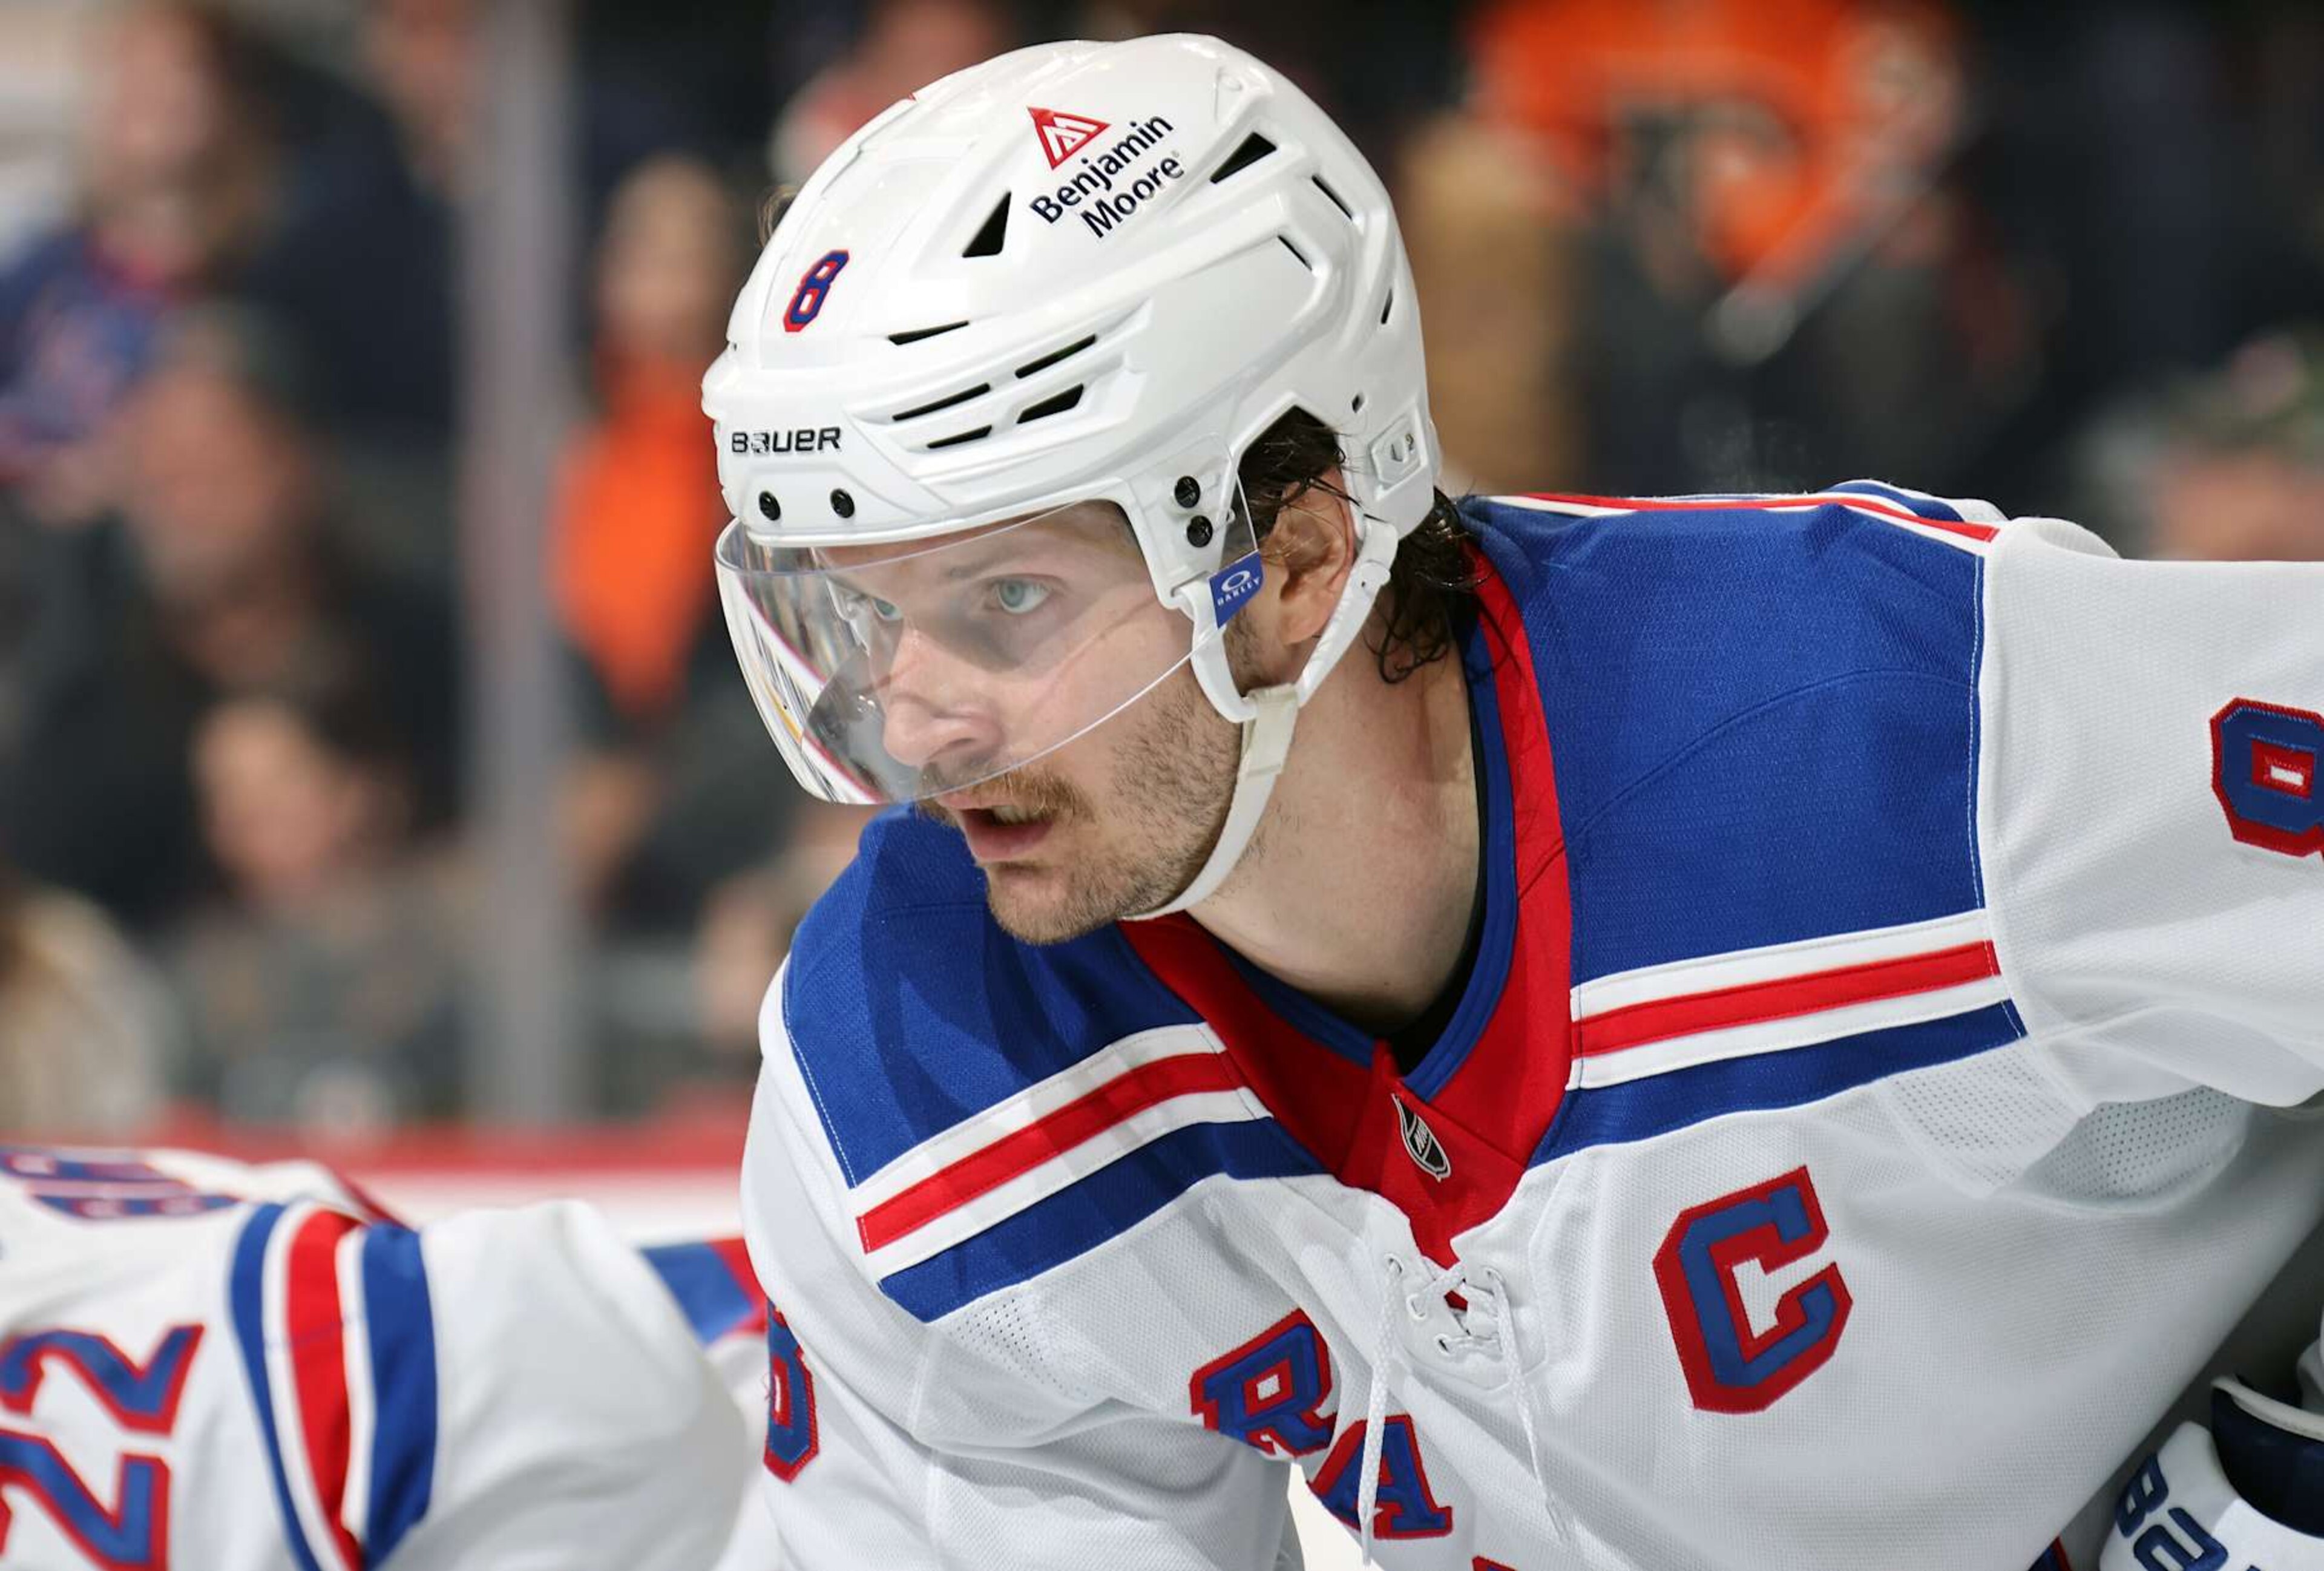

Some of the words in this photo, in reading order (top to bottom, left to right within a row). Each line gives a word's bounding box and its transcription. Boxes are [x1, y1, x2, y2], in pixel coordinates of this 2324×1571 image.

[1029, 116, 1174, 224] Benjamin
[1080, 157, 1184, 238] Moore
[783, 249, 850, 333] 8
[1652, 1164, 1853, 1414] C
